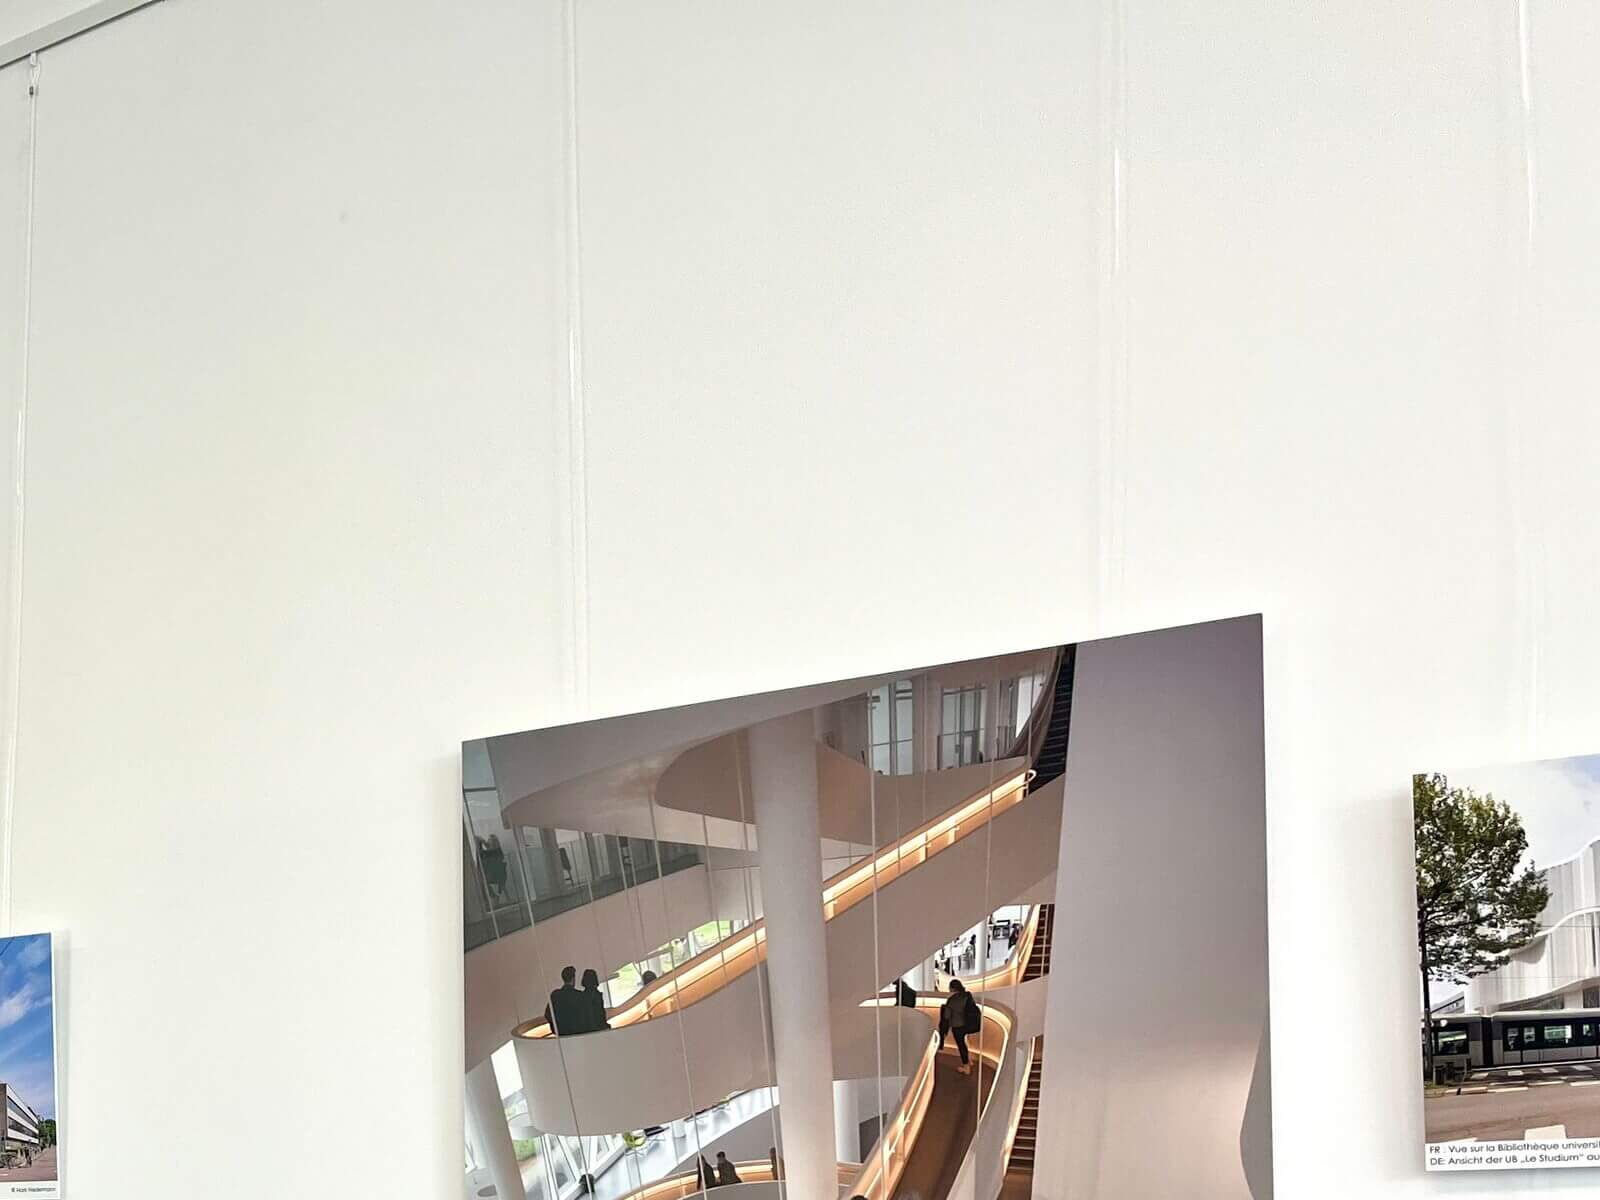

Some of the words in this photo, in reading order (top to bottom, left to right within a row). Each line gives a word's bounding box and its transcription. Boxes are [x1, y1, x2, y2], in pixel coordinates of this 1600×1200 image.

[1430, 1146, 1440, 1154] FR
[1449, 1145, 1467, 1153] Vue
[1486, 1144, 1495, 1152] la
[1498, 1142, 1559, 1154] Bibliothèque
[1449, 1156, 1483, 1165] Ansicht
[1486, 1156, 1502, 1164] der
[1505, 1156, 1518, 1164] UB
